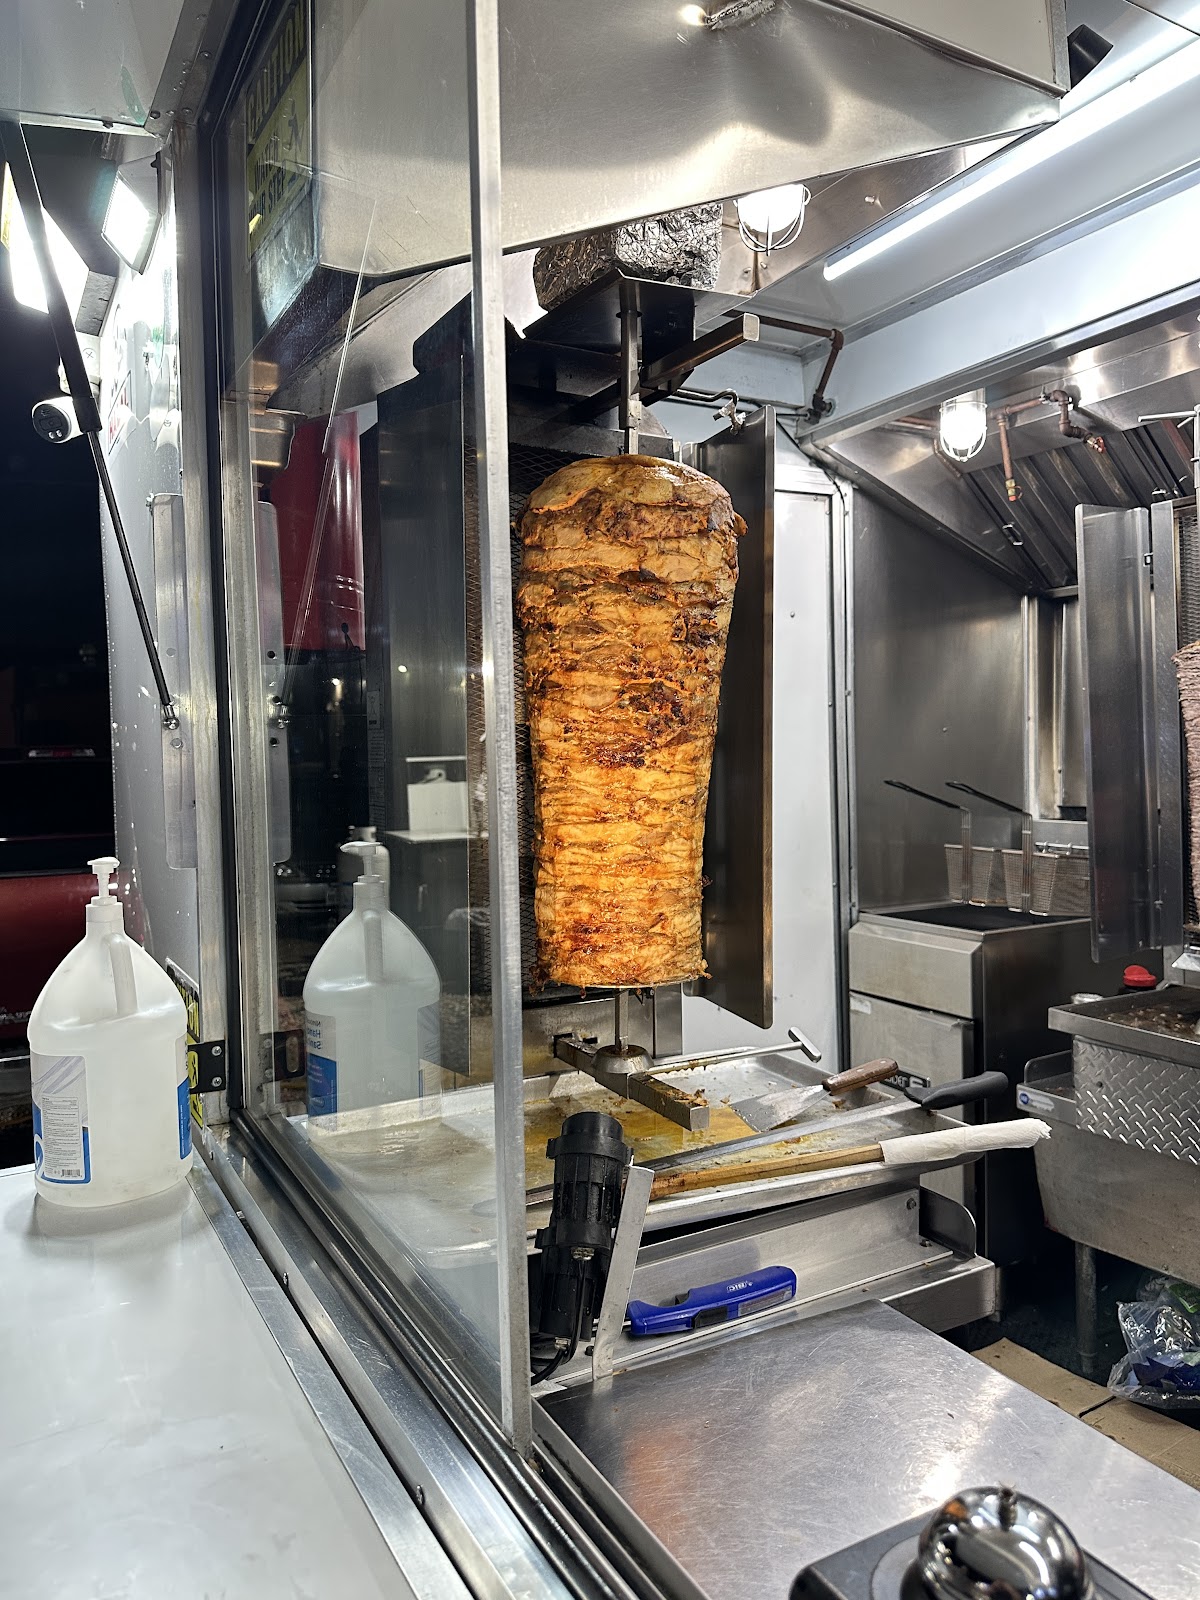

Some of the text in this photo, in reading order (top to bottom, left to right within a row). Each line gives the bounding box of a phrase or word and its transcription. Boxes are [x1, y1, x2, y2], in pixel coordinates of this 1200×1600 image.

[247, 0, 305, 144] CAUTION
[254, 130, 279, 194] WATCH
[268, 159, 287, 214] STEP
